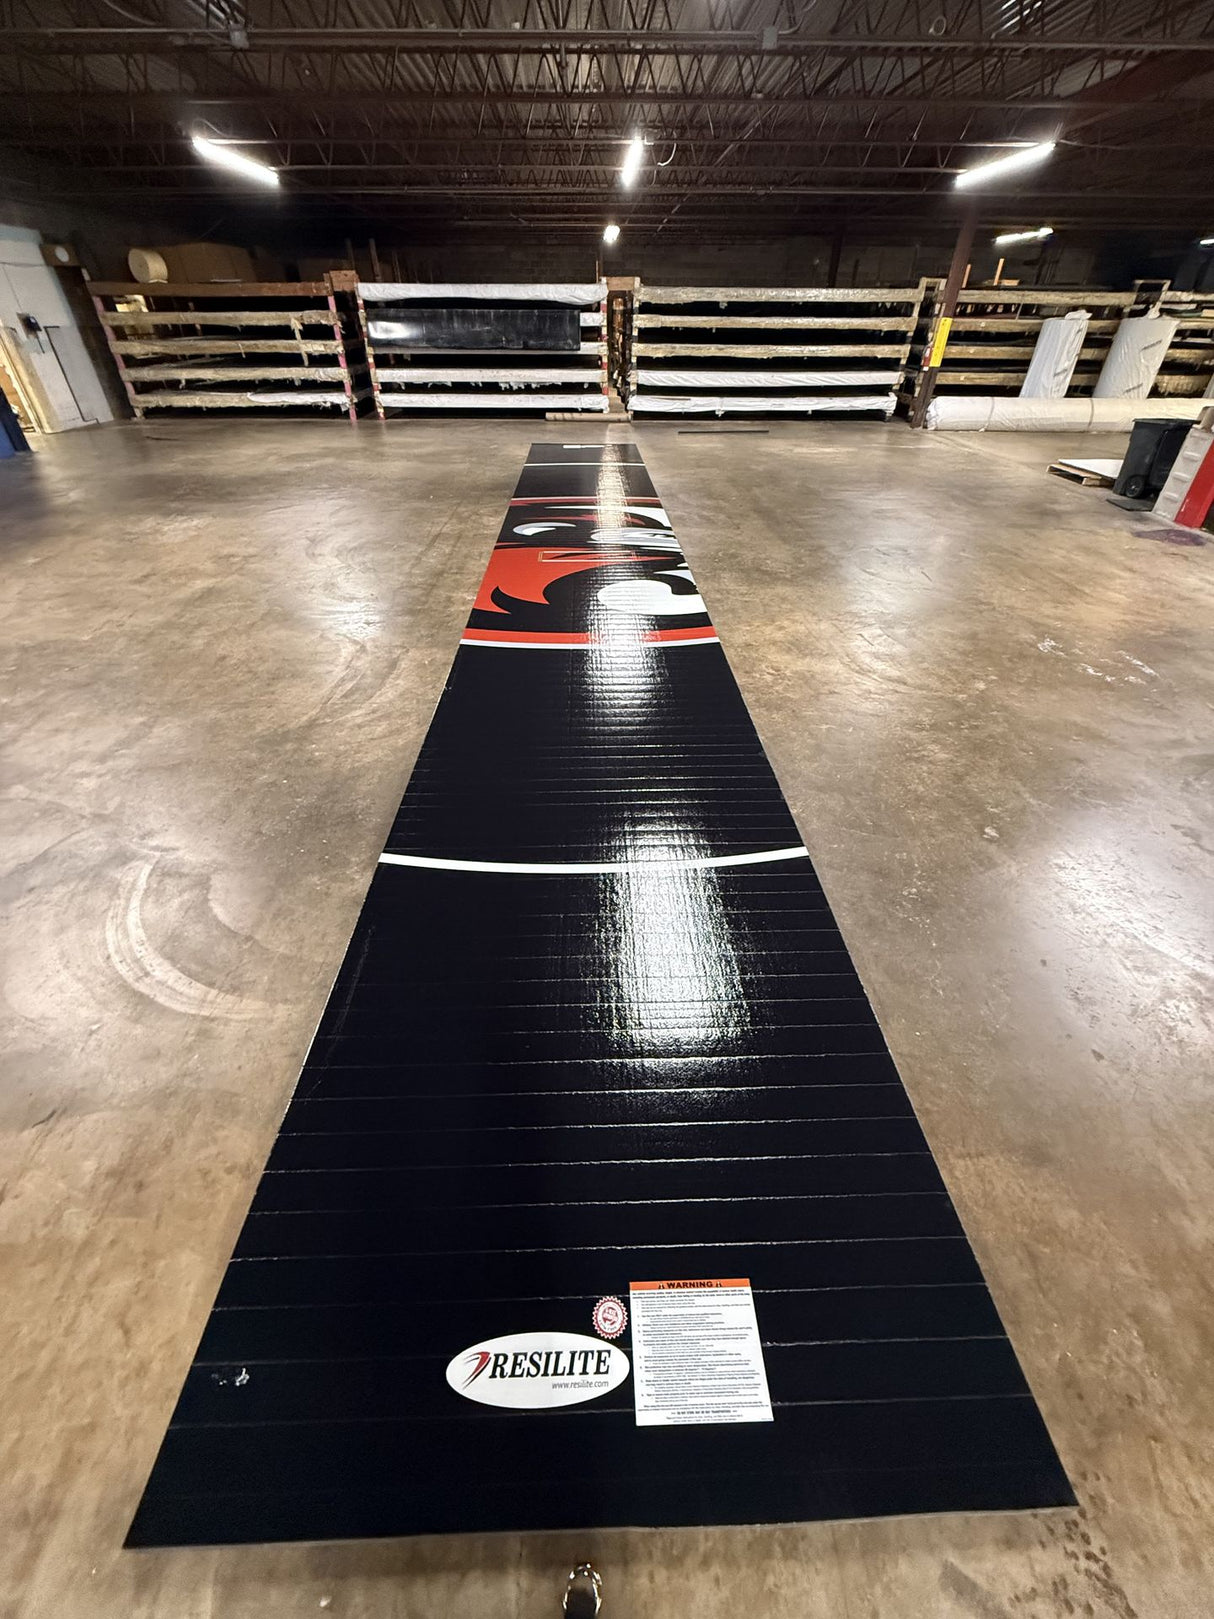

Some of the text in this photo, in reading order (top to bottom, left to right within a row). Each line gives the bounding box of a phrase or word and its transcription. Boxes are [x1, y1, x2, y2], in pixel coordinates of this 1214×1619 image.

[667, 1281, 713, 1289] WARNING
[489, 1350, 611, 1379] RESILITE
[552, 1380, 609, 1390] www.resilite.com
